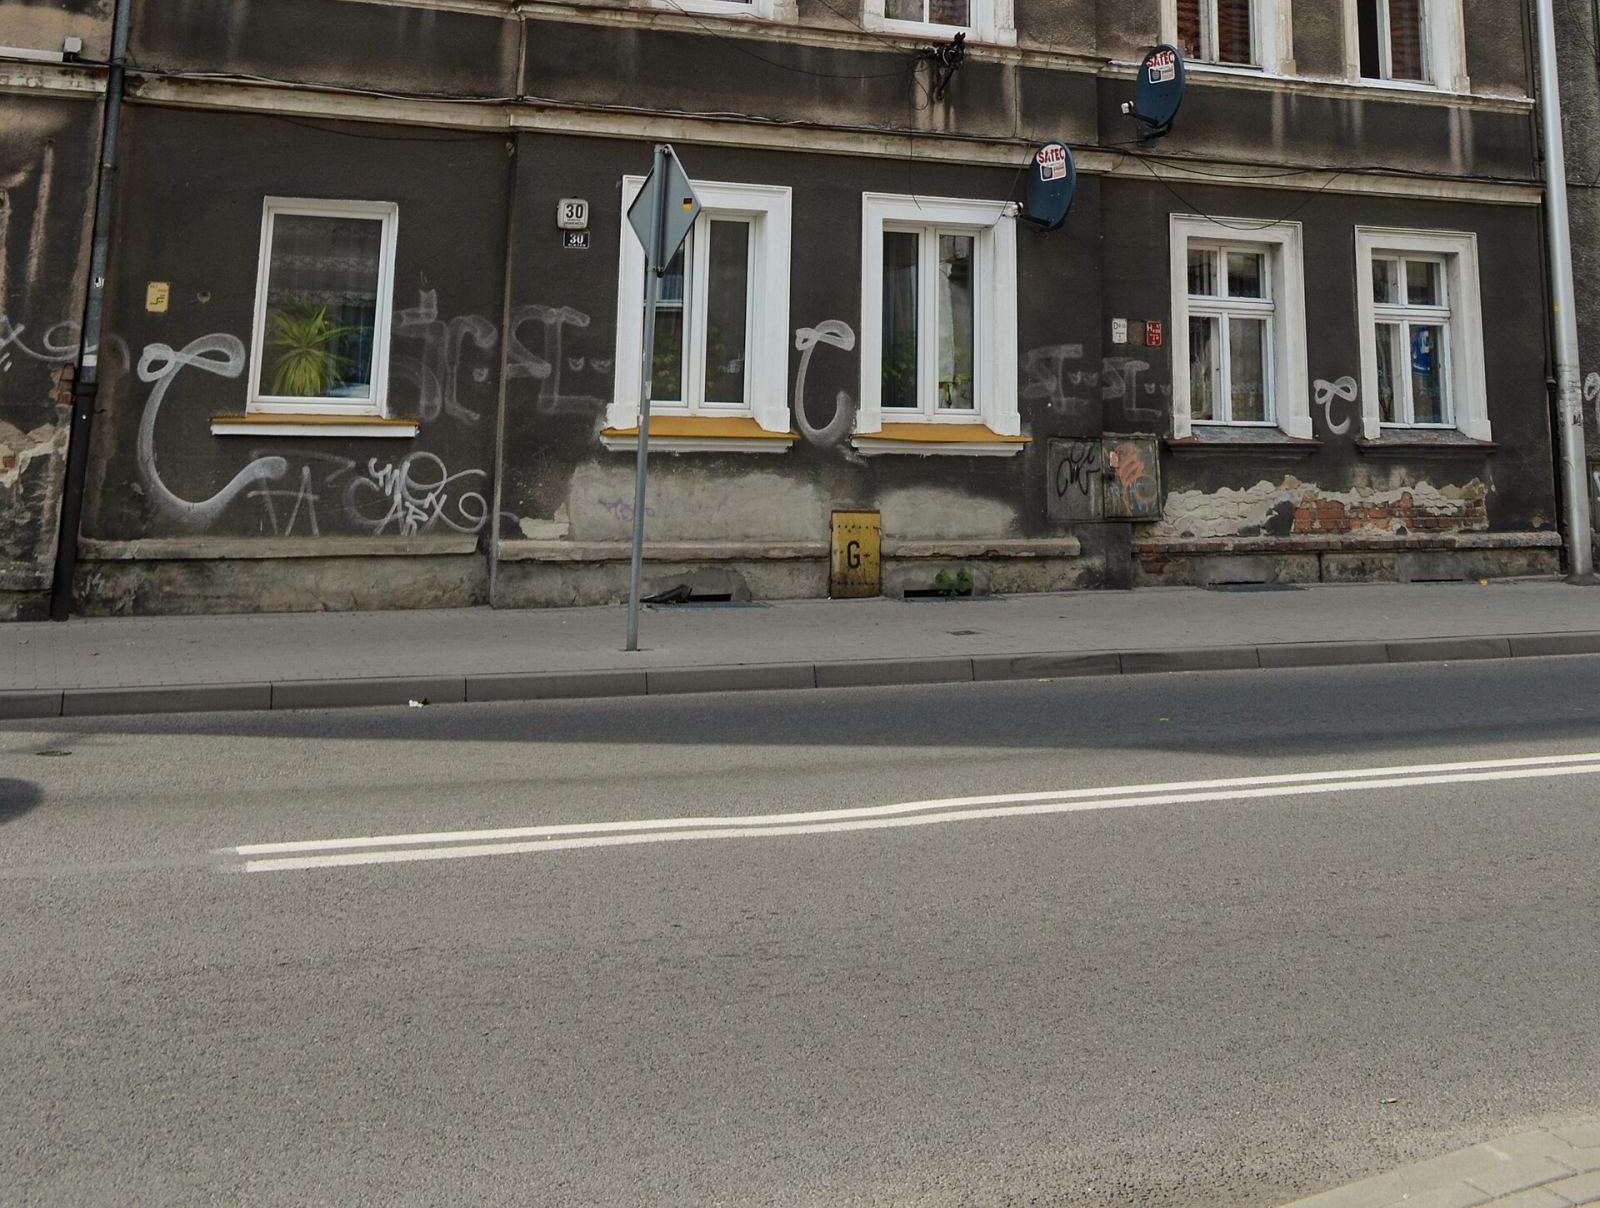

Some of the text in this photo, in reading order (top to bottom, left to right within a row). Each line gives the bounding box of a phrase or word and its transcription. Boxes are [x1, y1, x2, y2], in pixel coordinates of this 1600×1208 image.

[1147, 52, 1175, 67] SATEC
[1038, 148, 1065, 163] SATEC
[566, 203, 584, 219] 30
[570, 233, 584, 244] 30
[847, 540, 861, 569] G
